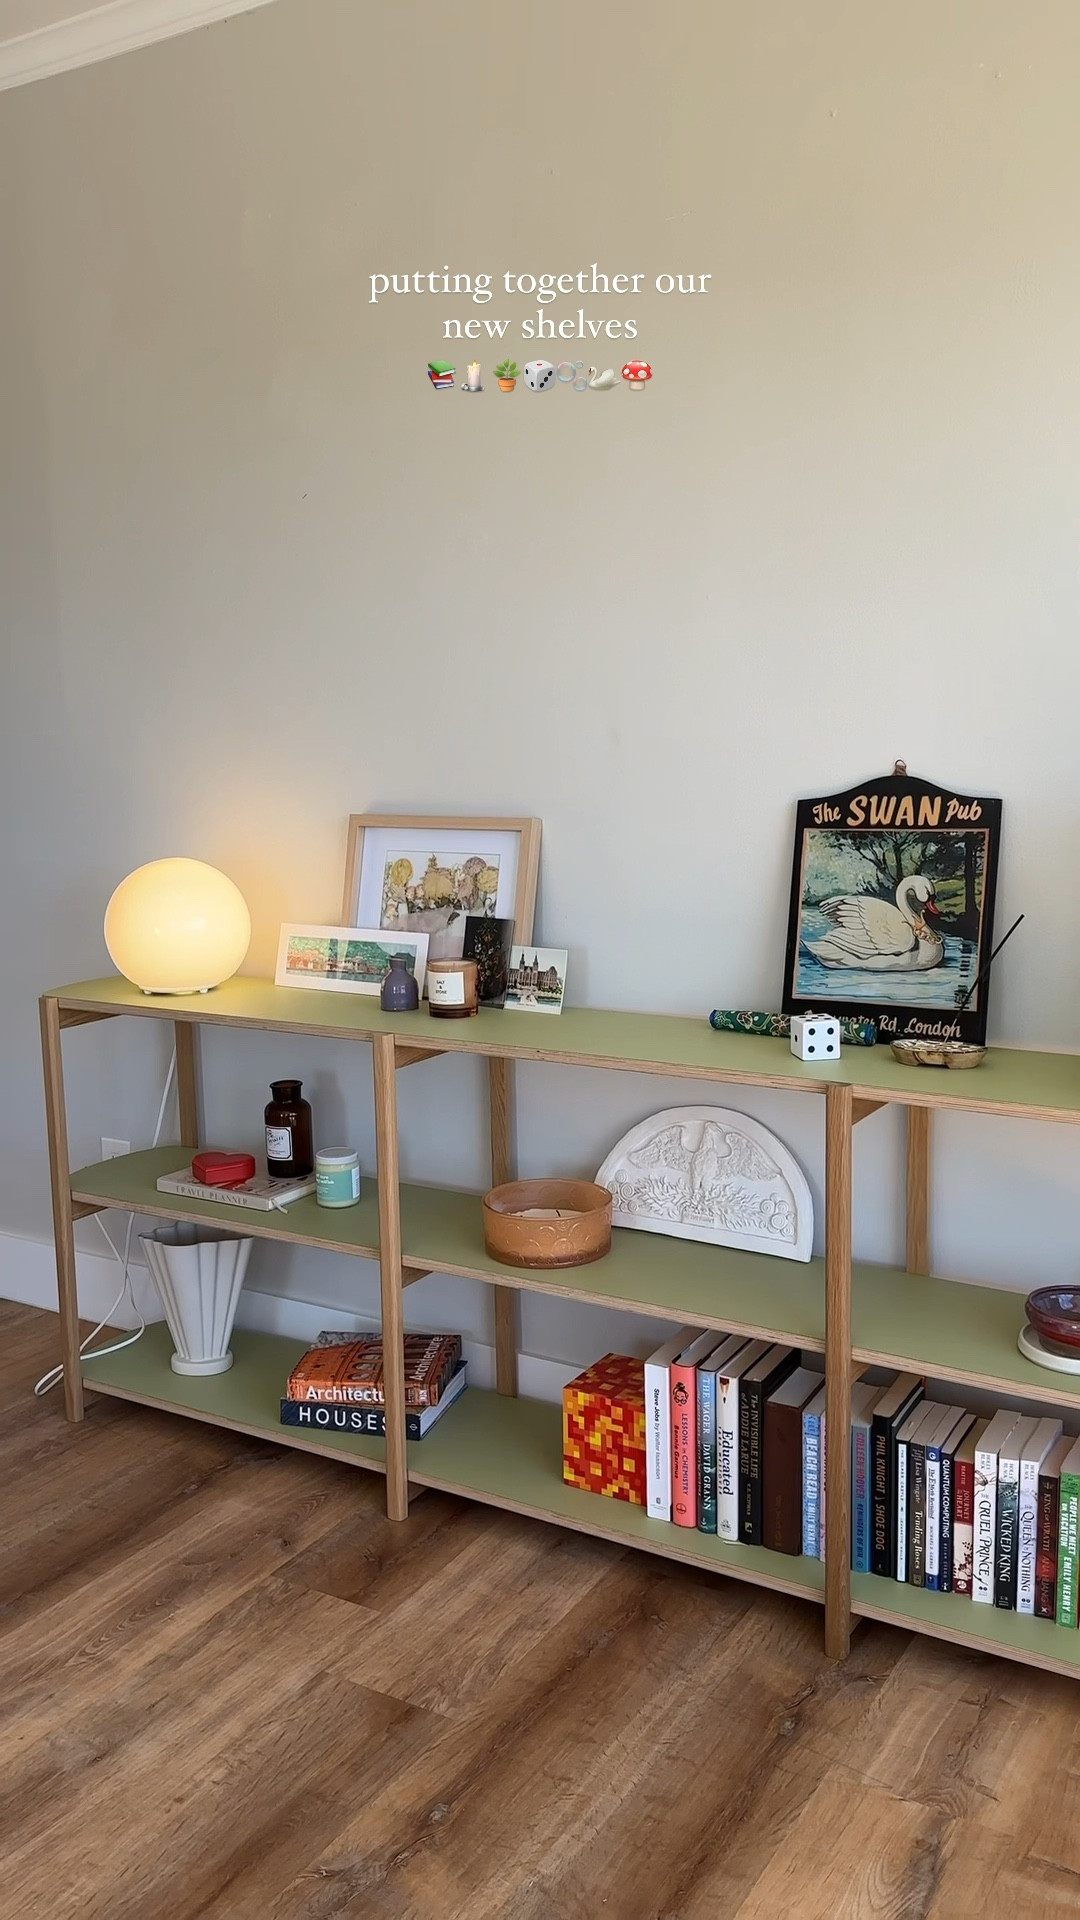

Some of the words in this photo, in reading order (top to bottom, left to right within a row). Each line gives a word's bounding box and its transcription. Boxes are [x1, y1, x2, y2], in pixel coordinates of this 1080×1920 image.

[812, 802, 841, 824] The
[846, 795, 942, 826] SWAN
[945, 798, 982, 823] Pub
[879, 1014, 901, 1032] Rd.
[904, 1018, 962, 1037] London
[176, 1185, 205, 1198] TRAVEL
[209, 1191, 250, 1206] PLANNER
[409, 1336, 444, 1381] Architecture
[305, 1385, 385, 1402] Architectu
[702, 1378, 711, 1398] THE
[741, 1392, 748, 1402] of
[653, 1423, 660, 1431] by
[681, 1413, 689, 1445] LESSONS
[702, 1401, 711, 1434] WAGER
[741, 1401, 749, 1437] ADDIE
[751, 1409, 759, 1456] INVISIBLE
[703, 1443, 711, 1474] DAVID
[806, 1437, 818, 1474] BEACH
[856, 1432, 865, 1466] COLLEEN
[876, 1435, 886, 1456] PHIL
[722, 1430, 734, 1496] Educated
[876, 1457, 886, 1494] KNIGHT
[915, 1462, 923, 1476] Lisa
[942, 1459, 950, 1496] QUANTUM
[703, 1475, 711, 1511] GRANN
[806, 1474, 818, 1500] READ
[856, 1466, 865, 1500] HOOVER
[912, 1476, 922, 1504] Wingate
[807, 1501, 816, 1524] EMILY
[875, 1504, 885, 1529] SHOE
[979, 1500, 991, 1535] CRUEL
[1043, 1492, 1051, 1513] KING
[1070, 1496, 1078, 1523] PEOPLE
[912, 1510, 923, 1544] Tending
[942, 1497, 950, 1539] COMPUTING
[1000, 1509, 1013, 1551] WICKED
[1021, 1511, 1034, 1546] QUEEN
[1060, 1512, 1069, 1547] VACATION
[1069, 1523, 1077, 1535] WE
[875, 1529, 885, 1550] DOG
[1043, 1521, 1051, 1552] WRATH
[1068, 1535, 1076, 1556] MEET
[915, 1545, 923, 1569] Roses
[976, 1537, 992, 1577] PRINCE
[997, 1553, 1011, 1583] KING
[1020, 1551, 1033, 1592] NOTHING
[1042, 1555, 1050, 1573] ANA
[1063, 1556, 1072, 1582] EMILY
[1041, 1574, 1050, 1603] HUANG
[1062, 1583, 1071, 1611] HENRY
